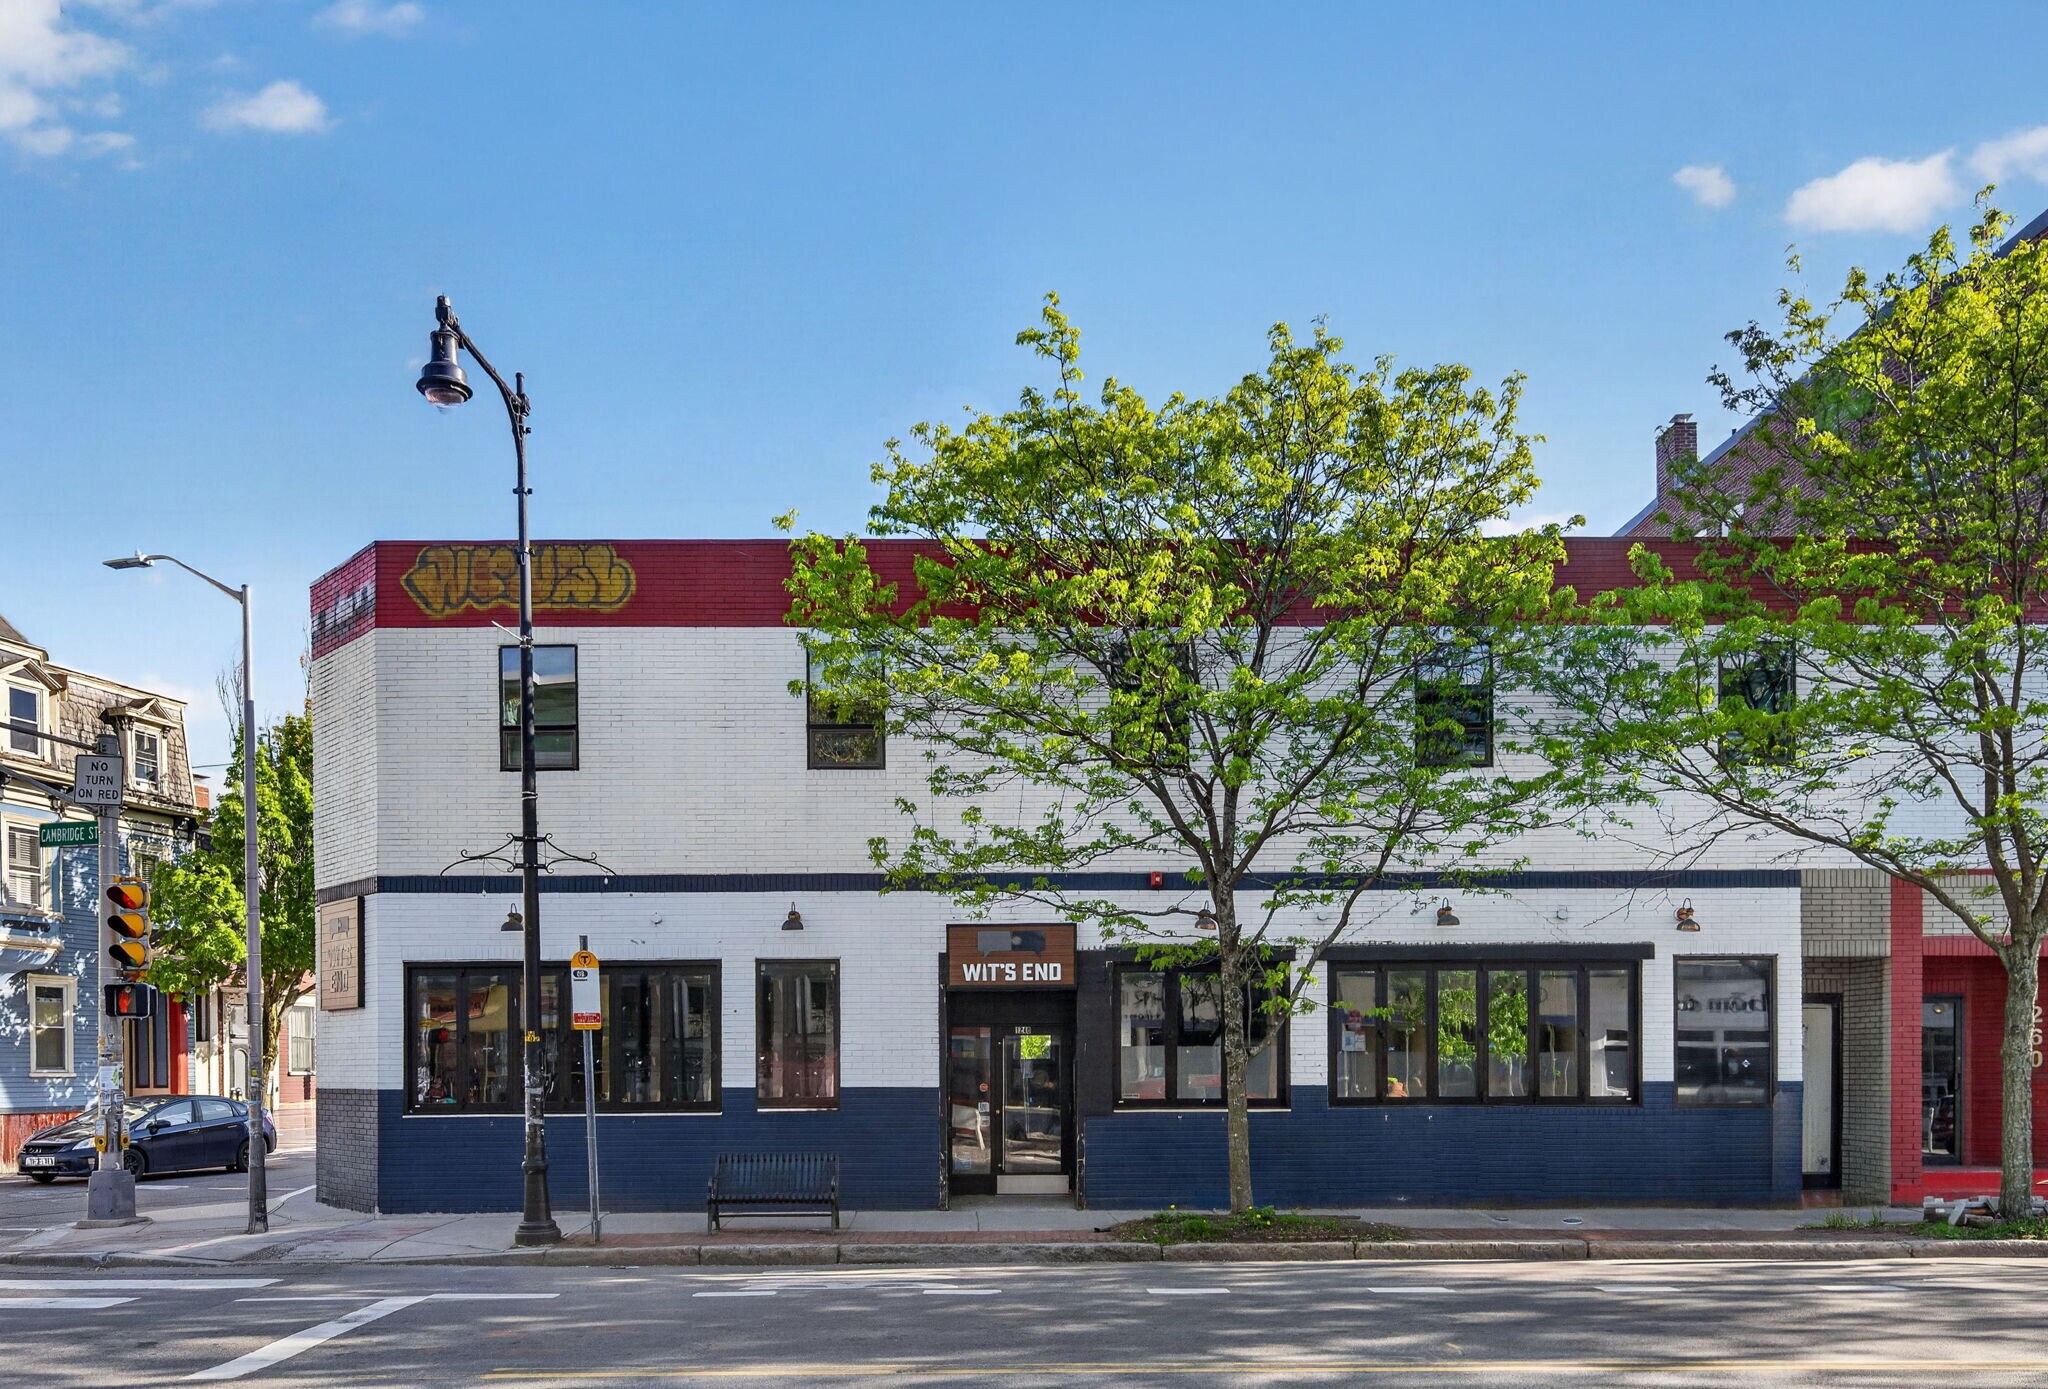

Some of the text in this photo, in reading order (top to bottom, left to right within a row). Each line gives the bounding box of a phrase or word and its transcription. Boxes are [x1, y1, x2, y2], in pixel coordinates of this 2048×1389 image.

[91, 761, 109, 772] NO
[85, 775, 114, 786] TURN
[78, 788, 119, 800] ON RED
[41, 826, 98, 843] CAMBRIDGE ST
[962, 963, 1062, 981] WIT'S END
[330, 969, 349, 993] END
